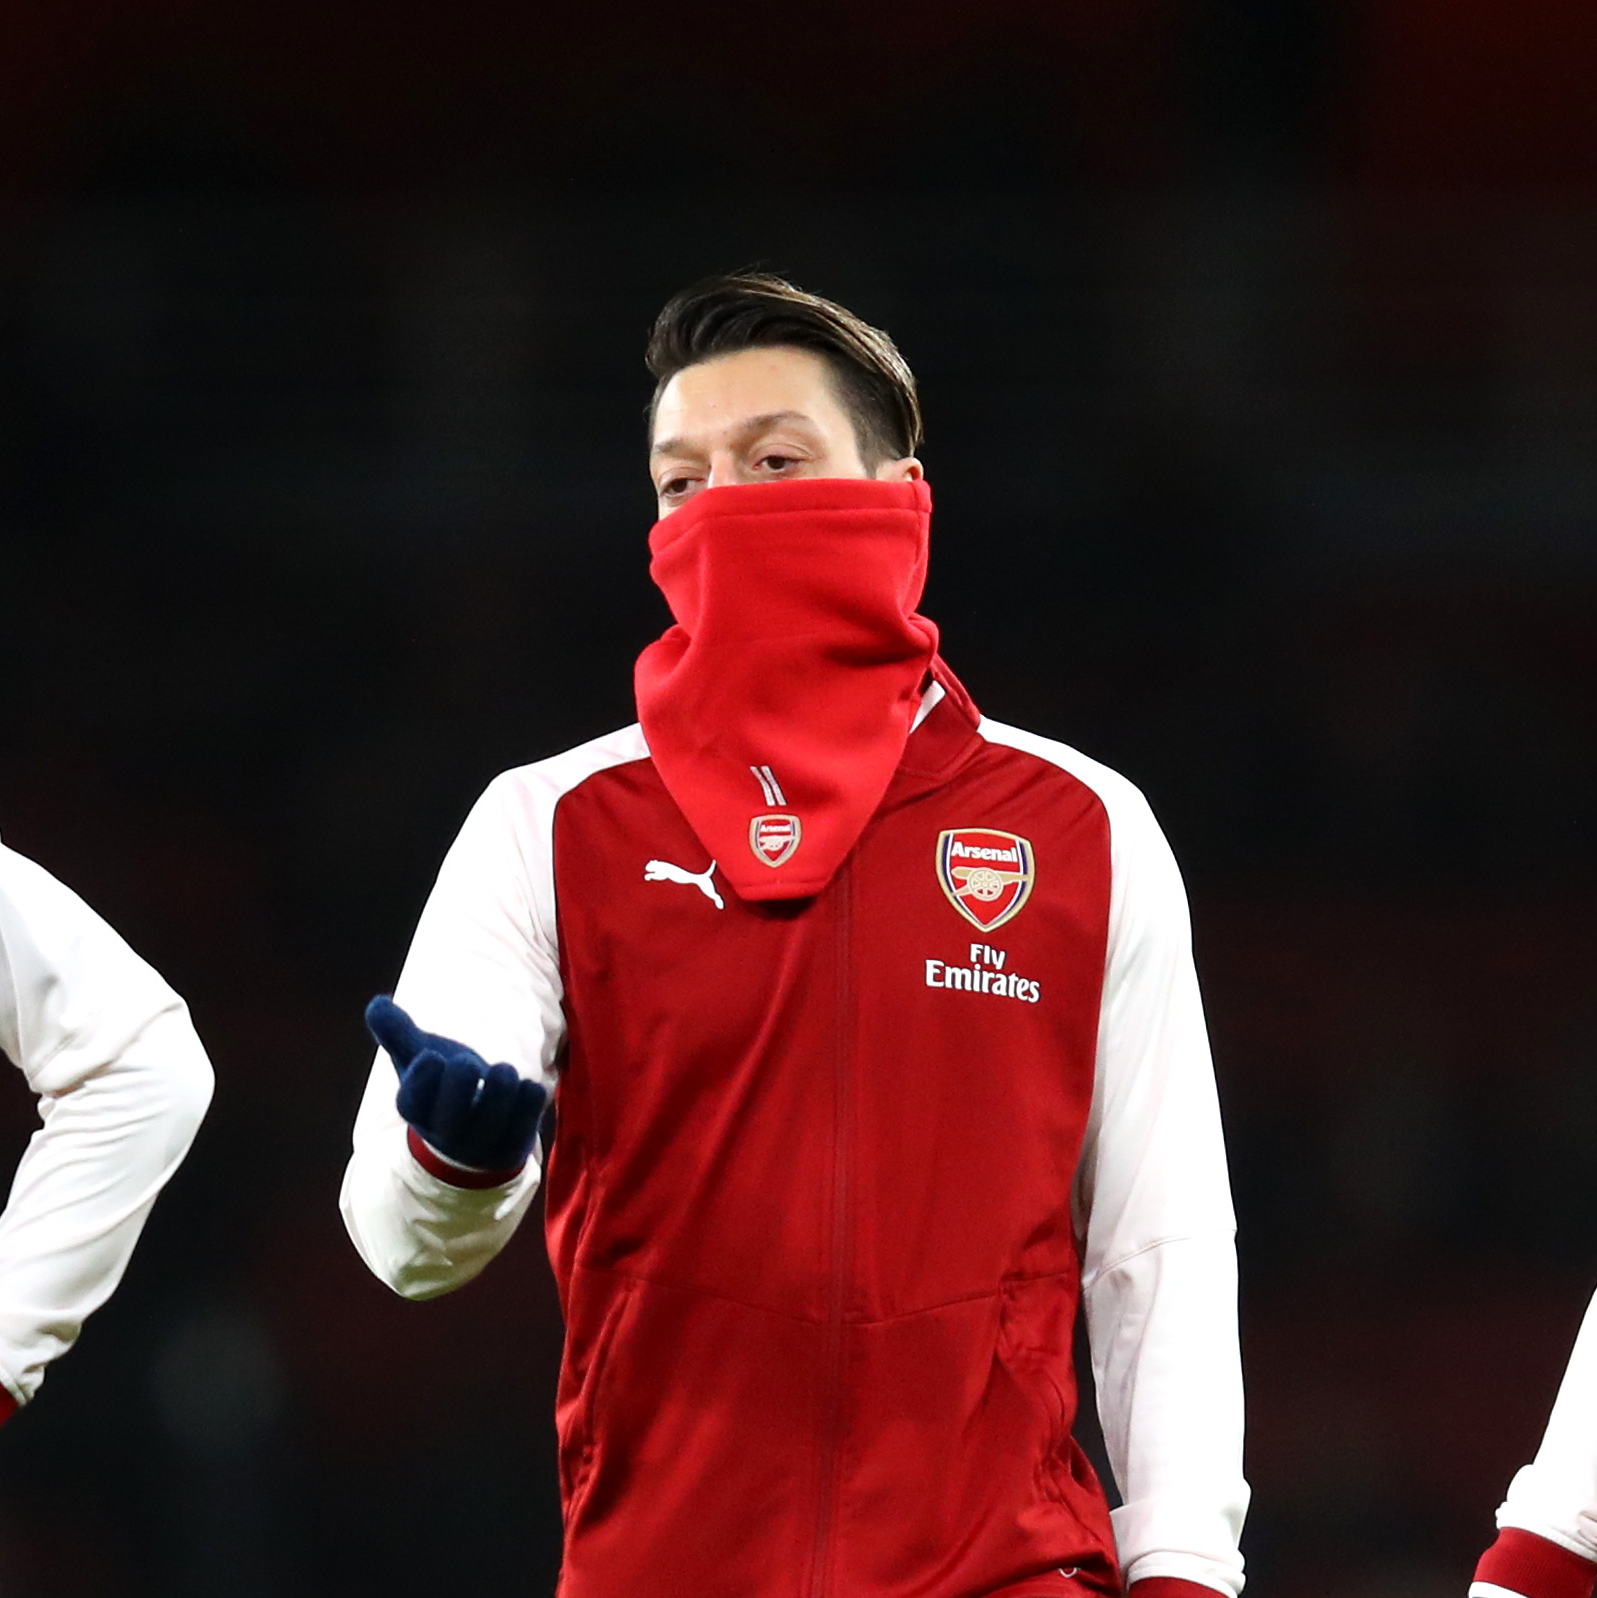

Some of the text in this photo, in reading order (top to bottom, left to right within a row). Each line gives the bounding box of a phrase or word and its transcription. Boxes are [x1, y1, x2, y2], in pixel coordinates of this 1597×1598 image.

[951, 841, 1018, 863] Arsenal
[970, 943, 1006, 970] Fly
[925, 959, 1041, 1003] Emirates
